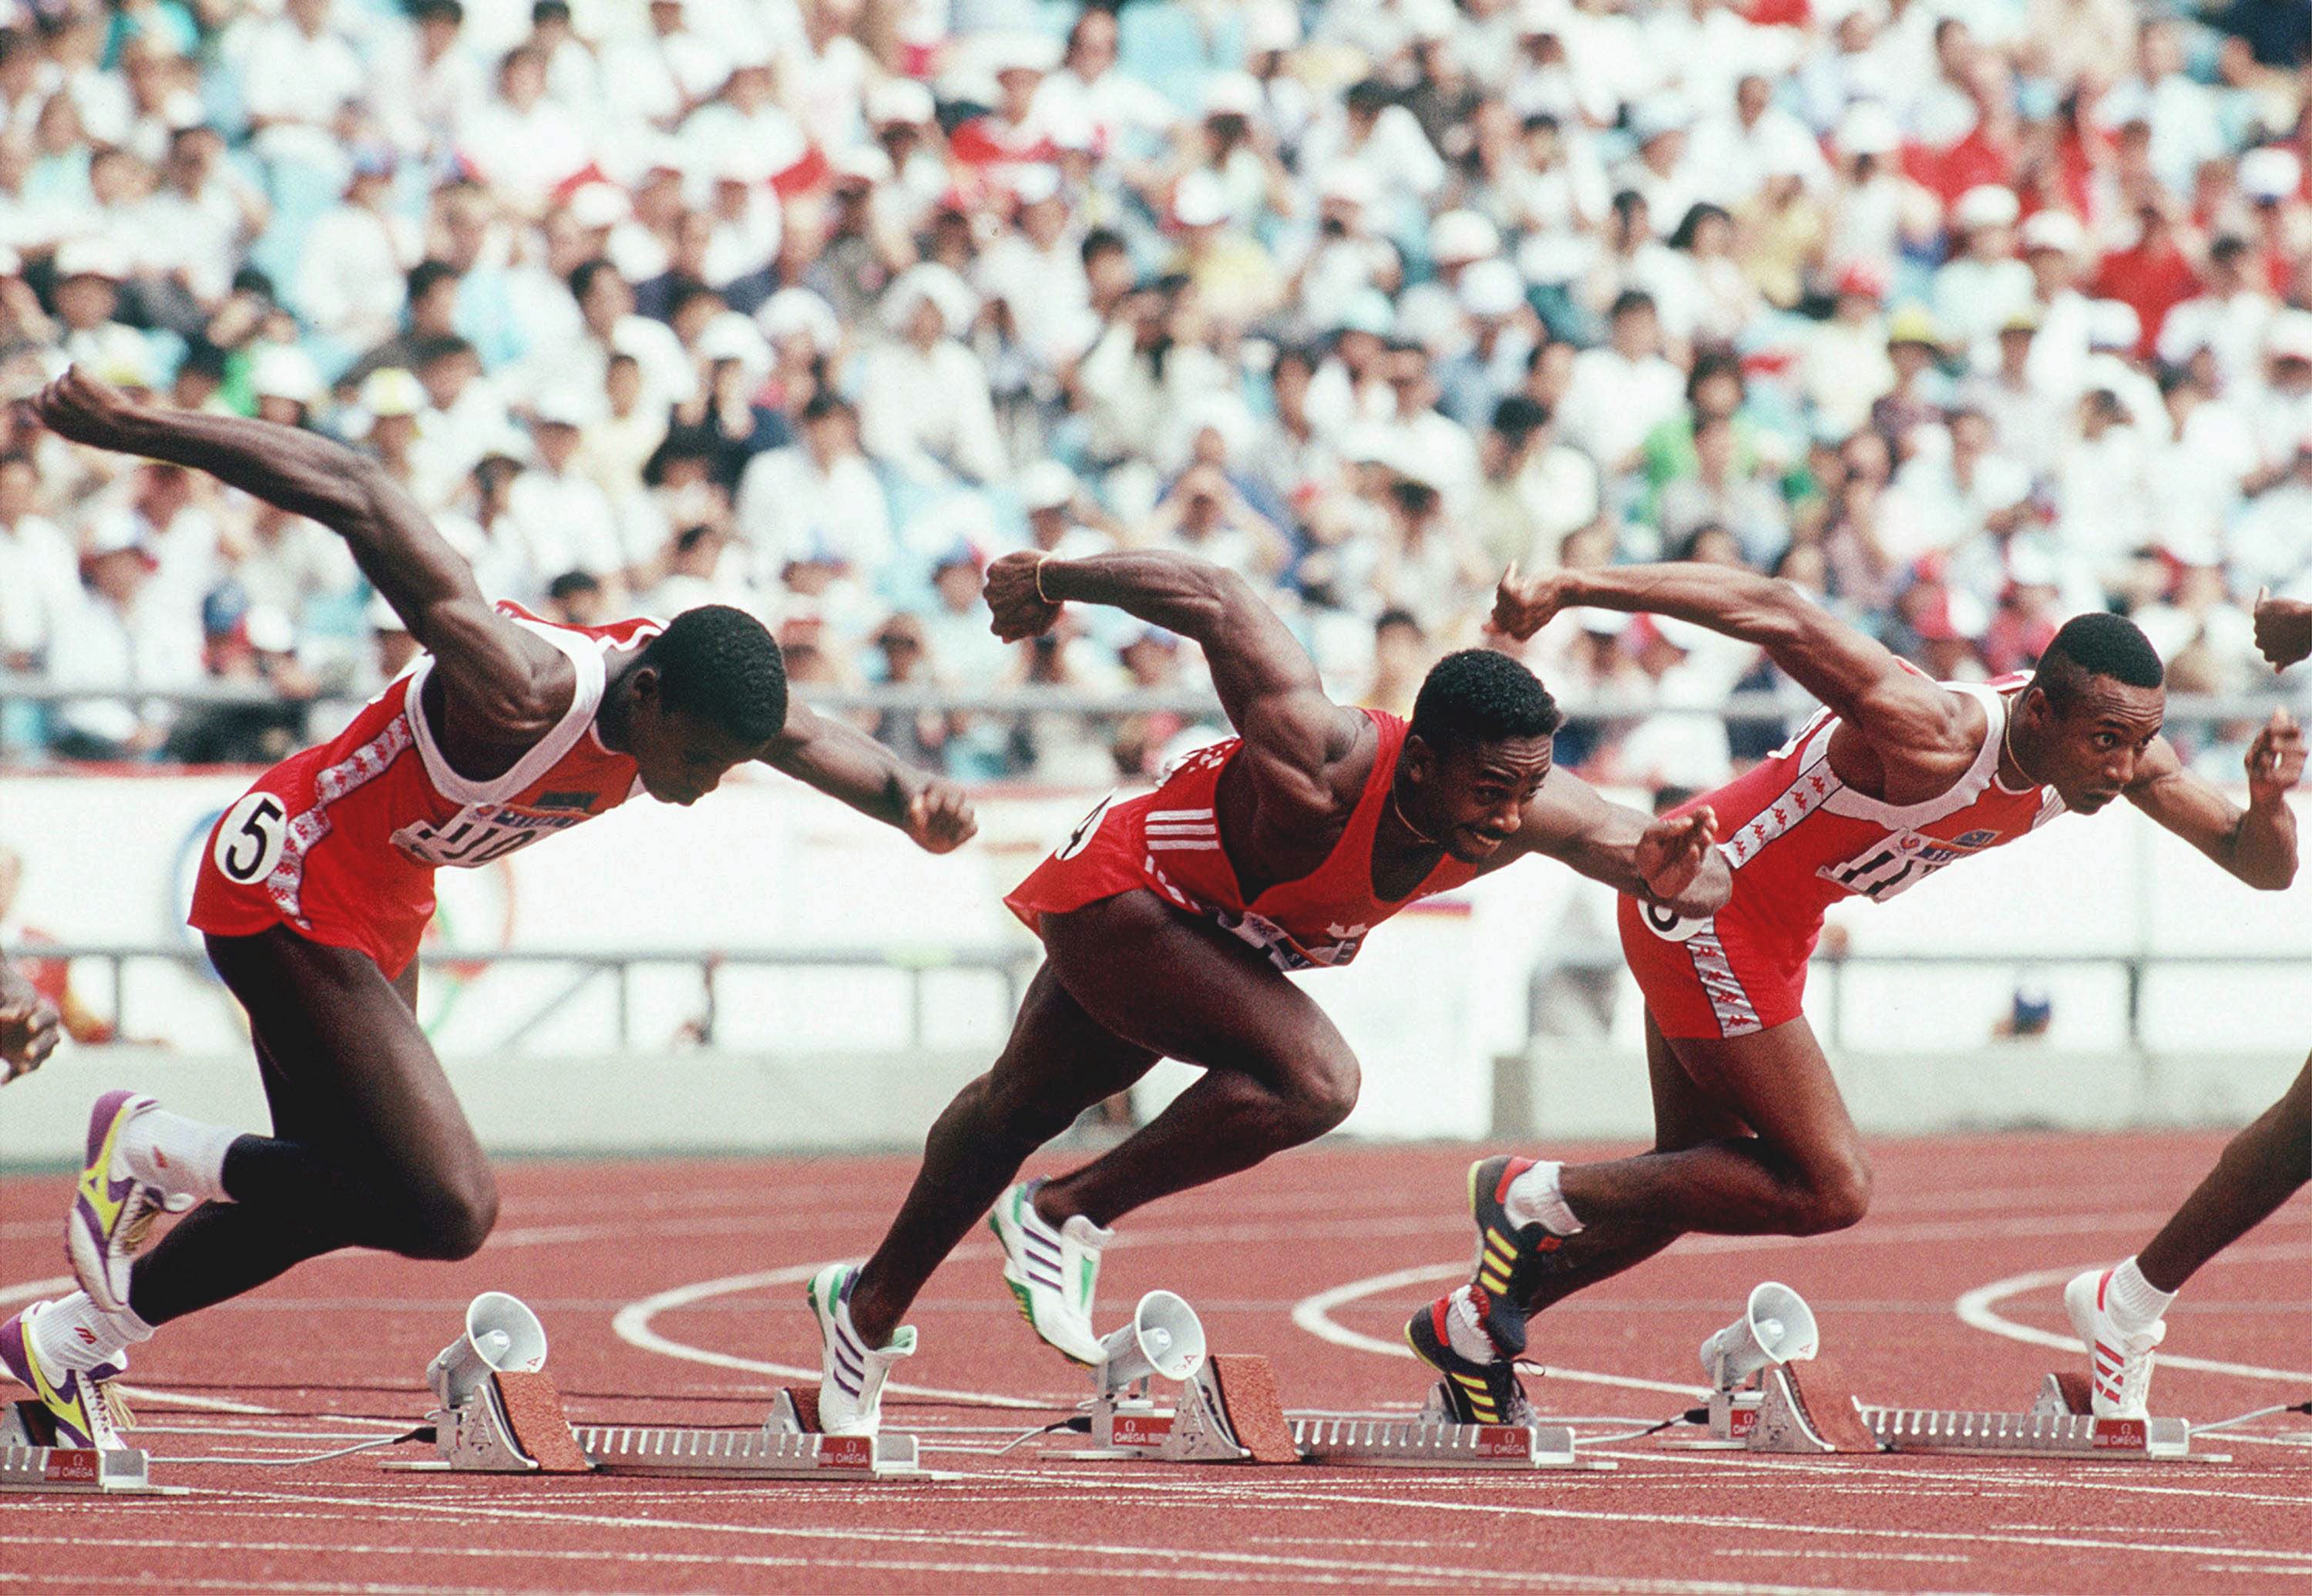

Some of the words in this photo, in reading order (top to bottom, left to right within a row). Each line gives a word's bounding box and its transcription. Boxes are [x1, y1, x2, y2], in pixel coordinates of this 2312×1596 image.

[226, 798, 283, 880] 5
[1114, 1432, 1147, 1443] OMEGA
[2110, 1435, 2142, 1446] OMEGA
[1494, 1443, 1526, 1455] OMEGA
[835, 1453, 868, 1463] OMEGA
[62, 1467, 94, 1478] OMEGA
